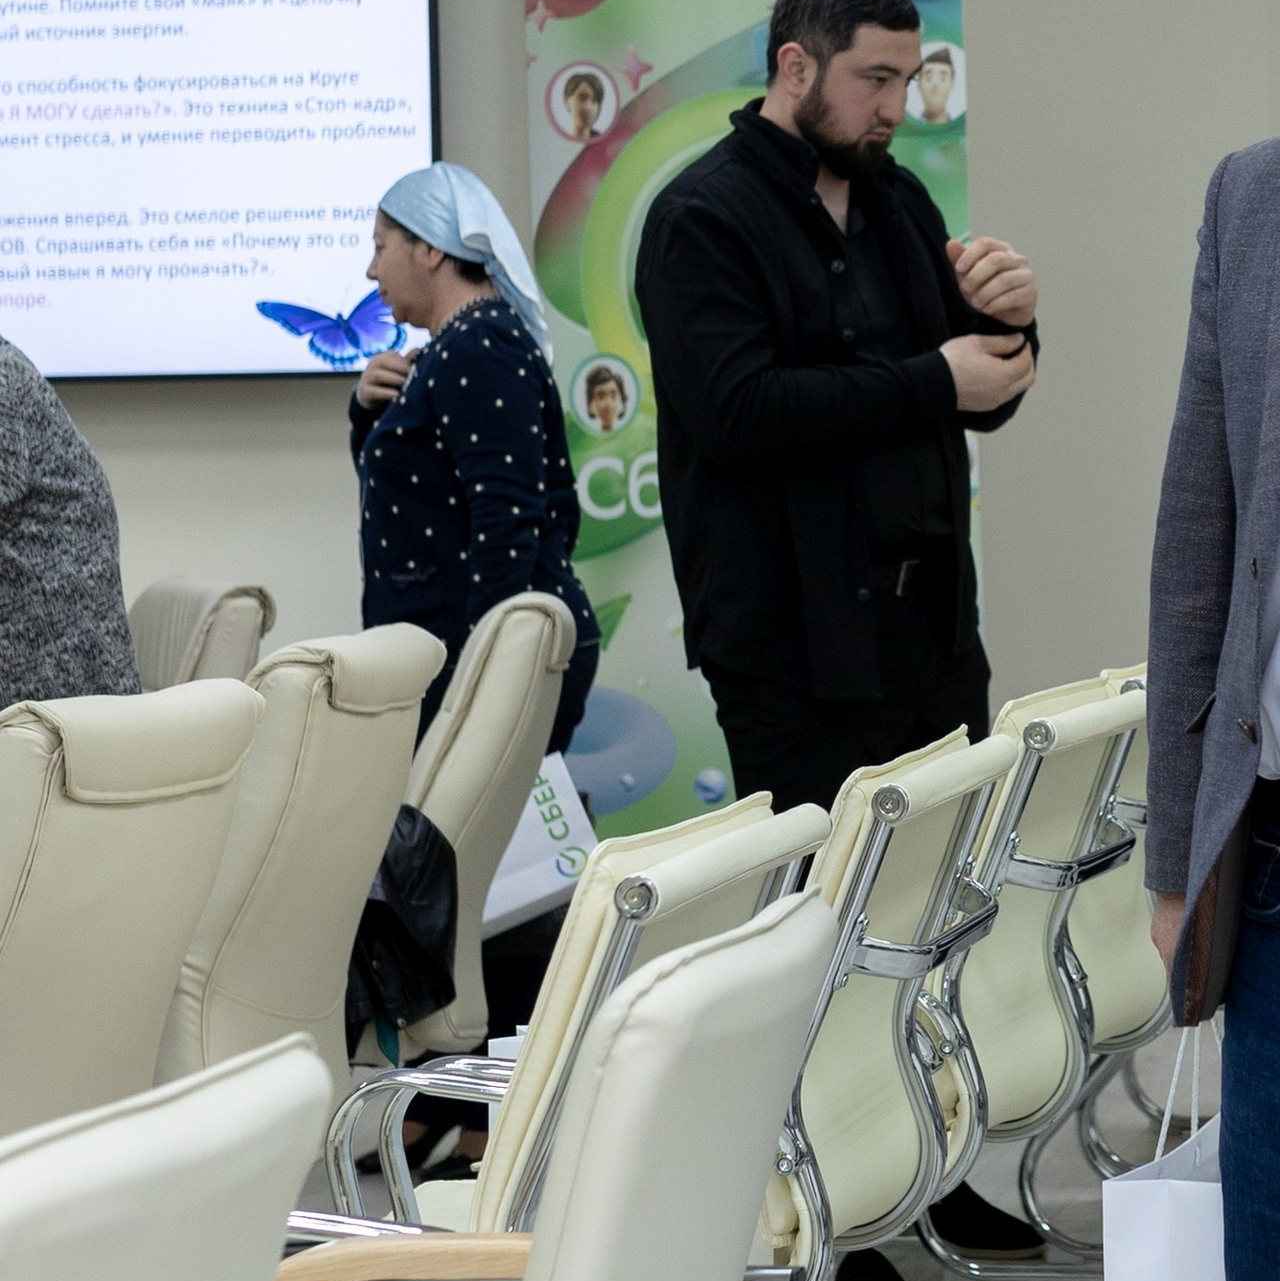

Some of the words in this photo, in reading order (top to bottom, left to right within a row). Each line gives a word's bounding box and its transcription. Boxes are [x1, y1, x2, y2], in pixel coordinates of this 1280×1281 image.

[25, 24, 105, 41] источник
[112, 23, 188, 41] энергии.
[17, 74, 128, 95] способность
[133, 73, 277, 94] фокусироваться
[283, 74, 304, 88] на
[309, 70, 360, 89] Круге
[10, 103, 20, 121] Я
[26, 102, 77, 121] МОГУ
[182, 97, 213, 118] Это
[219, 99, 288, 116] техника
[45, 130, 116, 150] стресса,
[122, 131, 132, 145] и
[137, 128, 204, 147] умение
[210, 126, 316, 145] переводить
[321, 121, 416, 143] проблемы
[64, 210, 132, 229] вперед.
[139, 206, 169, 226] Это
[174, 208, 240, 224] смелое
[246, 205, 327, 224] решение
[35, 235, 144, 257] Спрашивать
[148, 232, 189, 252] себя
[195, 236, 215, 251] не
[222, 231, 300, 250] «Почему
[306, 233, 334, 248] это
[339, 233, 360, 248] со
[36, 266, 91, 282] навык
[96, 267, 105, 280] я
[110, 264, 151, 282] могу
[0, 293, 51, 312] поре.
